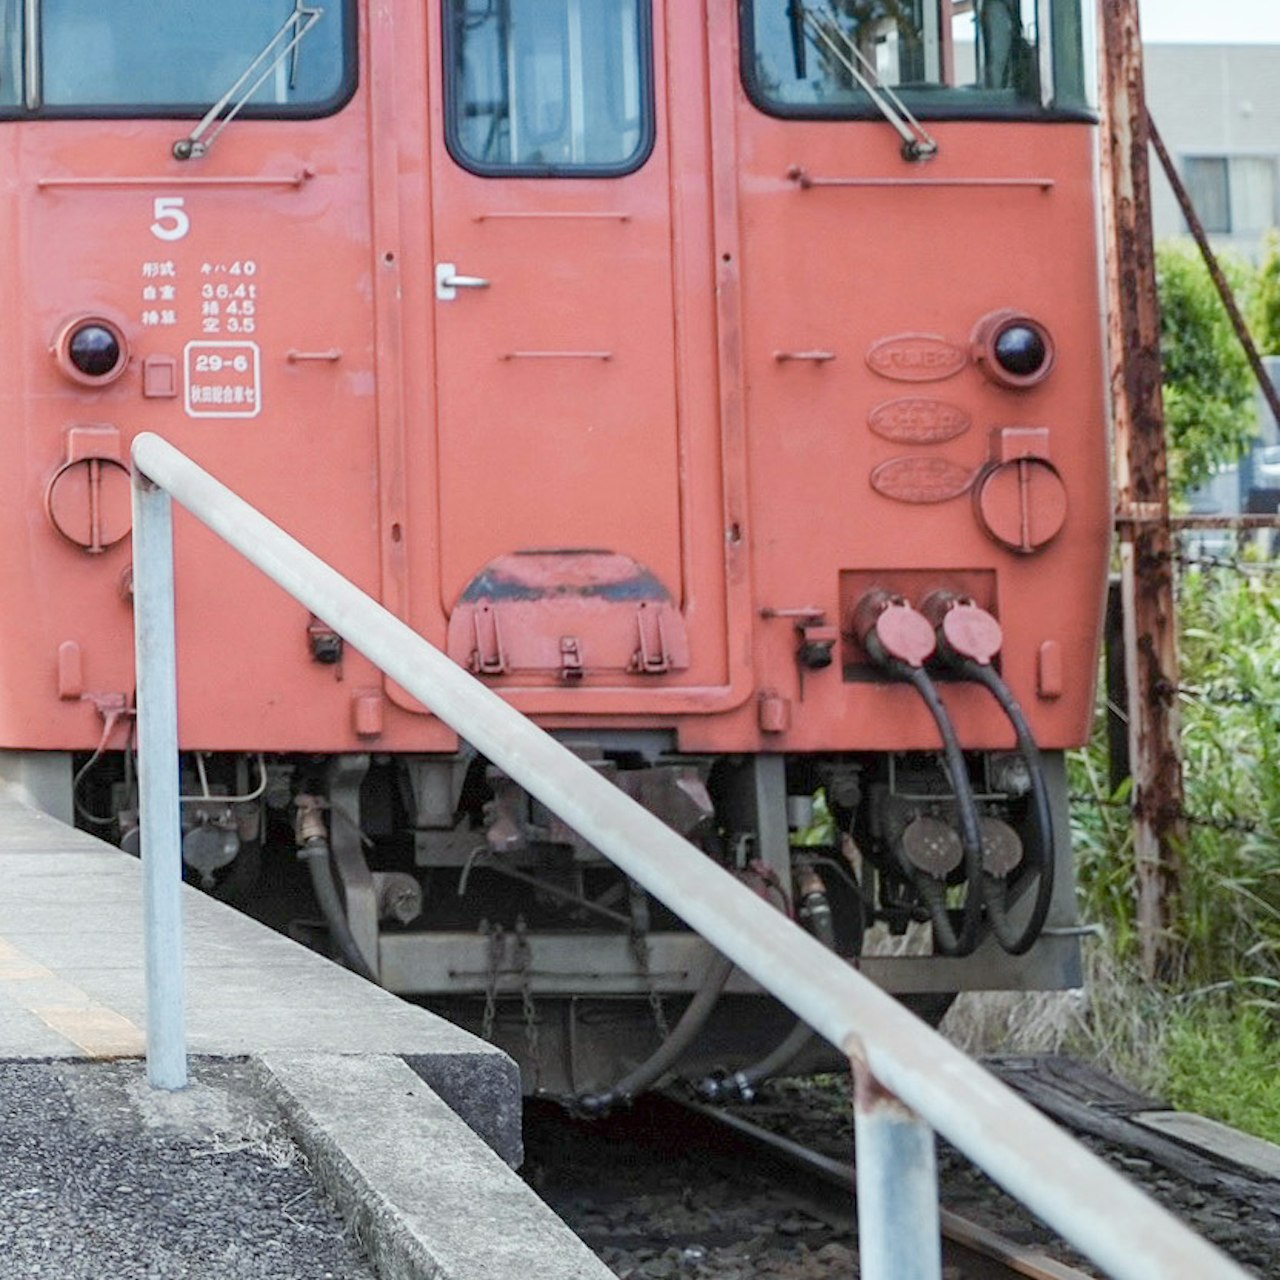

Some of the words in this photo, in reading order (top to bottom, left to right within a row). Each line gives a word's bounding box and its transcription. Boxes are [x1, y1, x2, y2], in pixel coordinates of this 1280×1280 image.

[150, 197, 190, 241] 5
[142, 261, 177, 277] 形式
[201, 261, 256, 276] キハ40
[201, 283, 257, 299] 36.4t
[226, 300, 256, 315] 4.5
[227, 317, 256, 333] 3.5
[196, 355, 248, 372] 29-6
